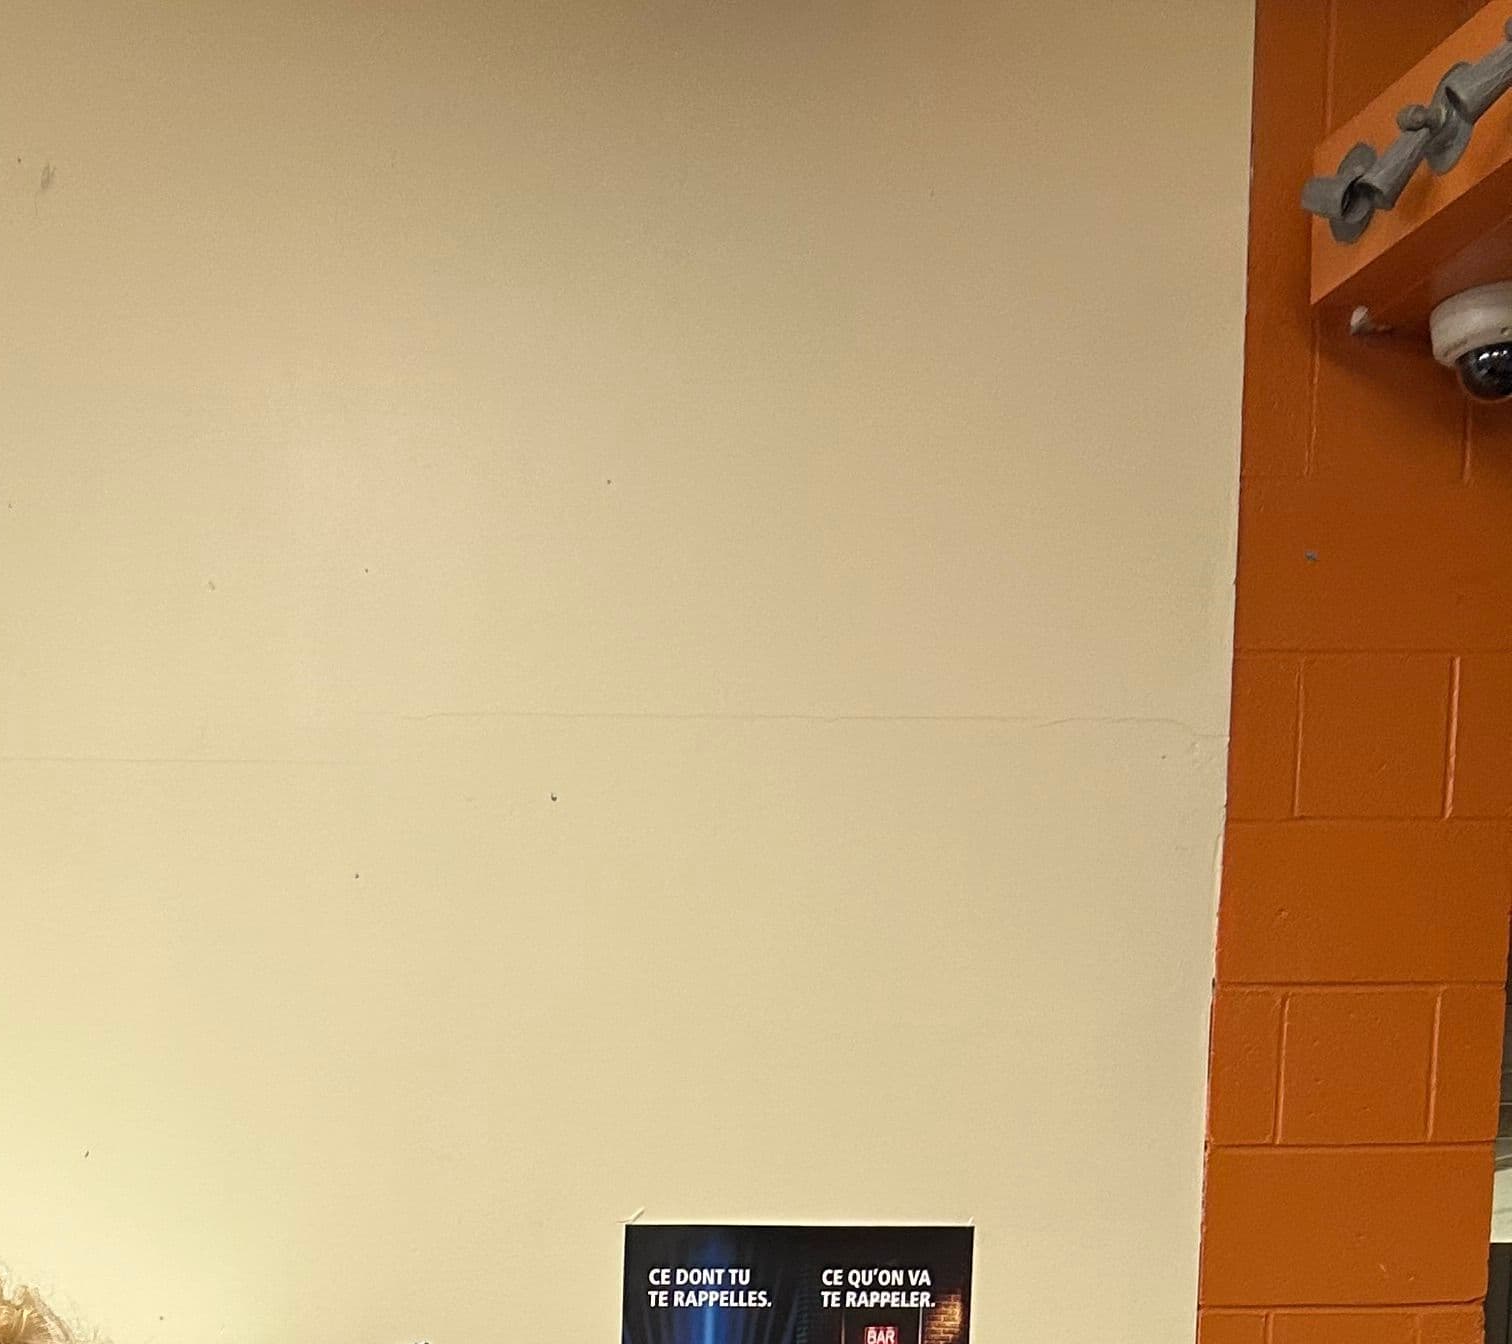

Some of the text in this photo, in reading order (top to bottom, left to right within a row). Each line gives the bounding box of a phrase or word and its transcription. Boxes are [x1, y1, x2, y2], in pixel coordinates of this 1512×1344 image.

[648, 1268, 751, 1286] CE DONT TU
[822, 1268, 931, 1288] CE QU'ON VA
[647, 1290, 772, 1307] TE RAPPELLES.
[821, 1291, 936, 1307] TE RAPPELER.
